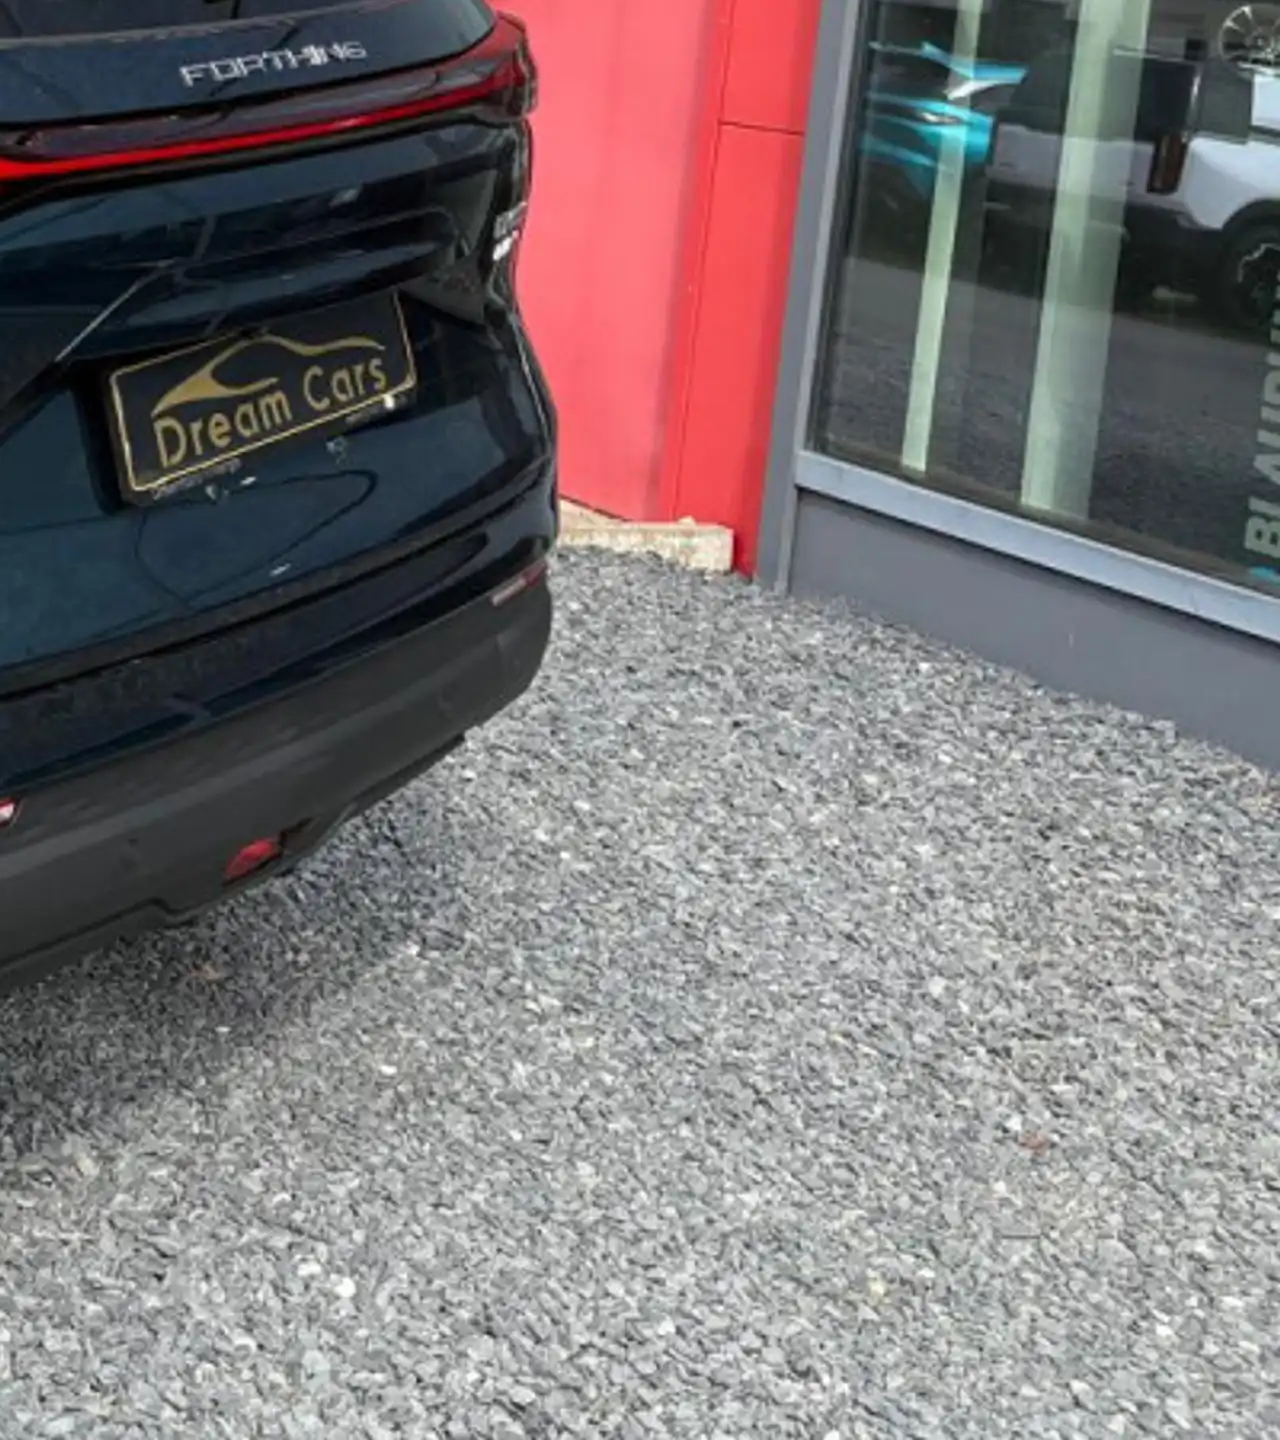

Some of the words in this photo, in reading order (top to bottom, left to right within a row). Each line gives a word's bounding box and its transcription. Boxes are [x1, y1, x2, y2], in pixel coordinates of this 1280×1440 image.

[179, 40, 368, 89] FORTHING
[153, 388, 293, 469] Dream
[302, 357, 387, 411] Cars
